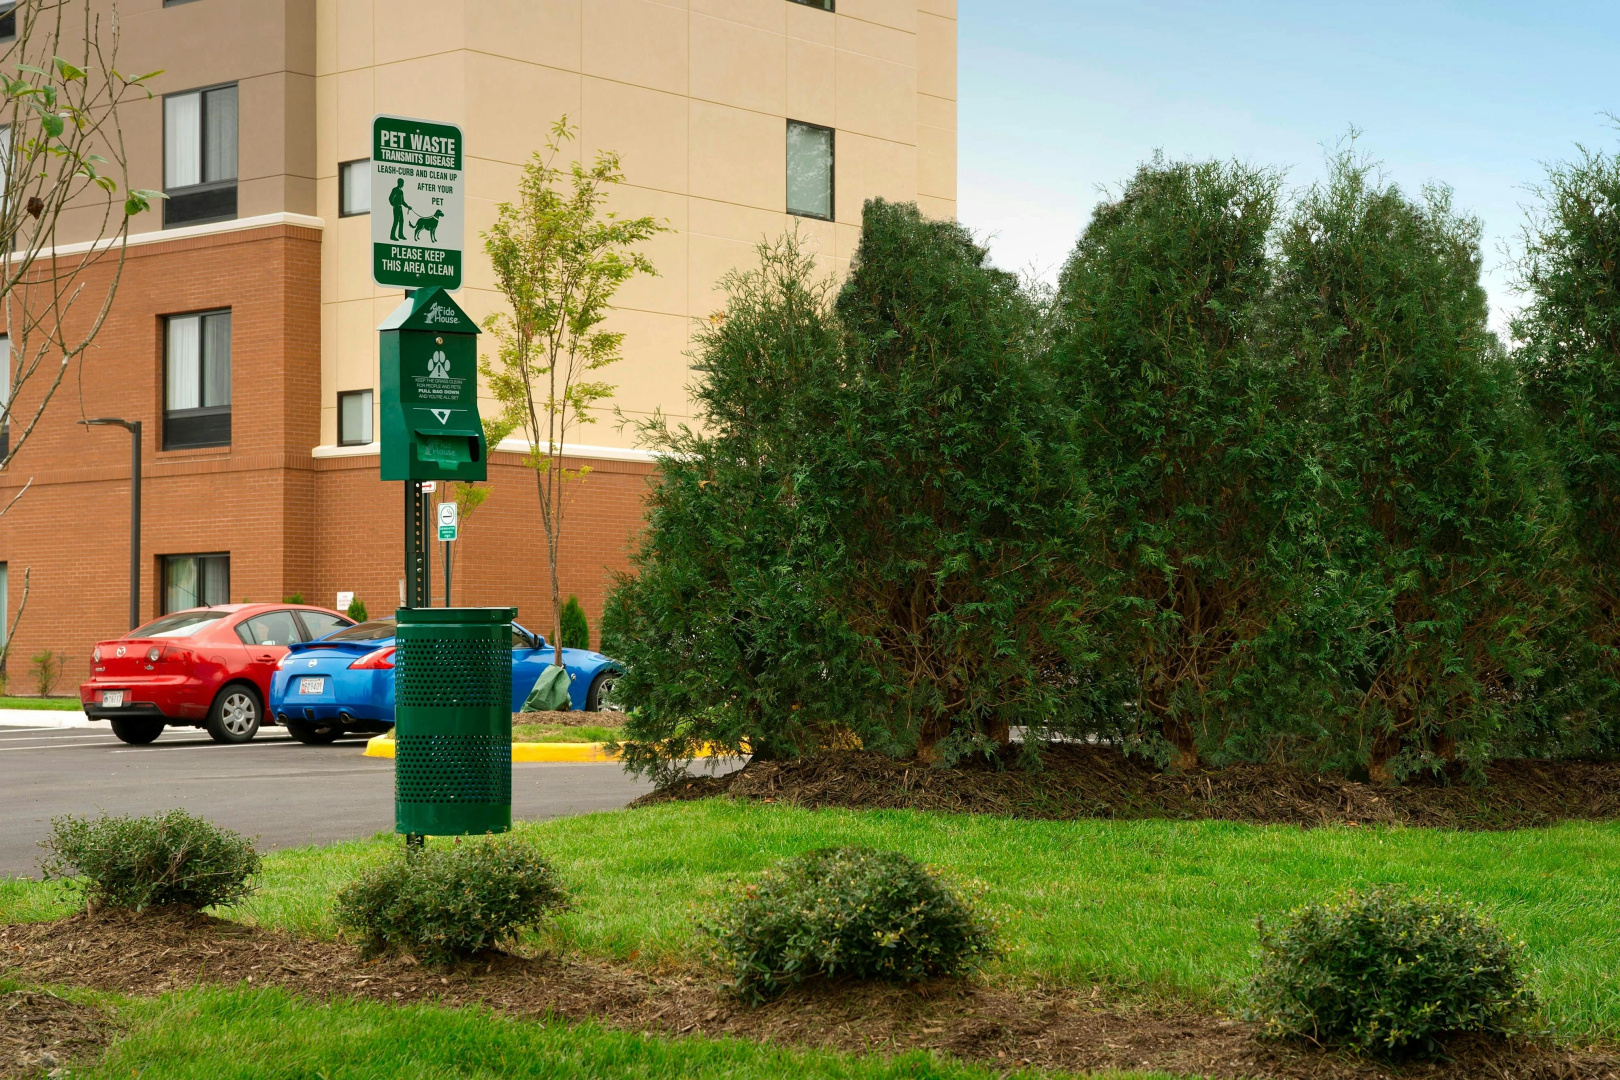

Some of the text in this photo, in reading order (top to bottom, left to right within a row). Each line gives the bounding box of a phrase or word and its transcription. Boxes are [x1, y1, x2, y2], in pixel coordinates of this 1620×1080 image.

[380, 129, 455, 154] PET WASTE
[381, 149, 455, 168] TRANSMITS DISEASE
[377, 164, 458, 182] LEASH-CURB AND CLEAN UP
[417, 182, 453, 194] AFTER YOUR
[431, 197, 444, 206] PET
[391, 246, 446, 262] PLEASE KEEP
[381, 258, 454, 276] THIS AREA CLEAN
[434, 314, 459, 324] House
[437, 306, 455, 316] Fido
